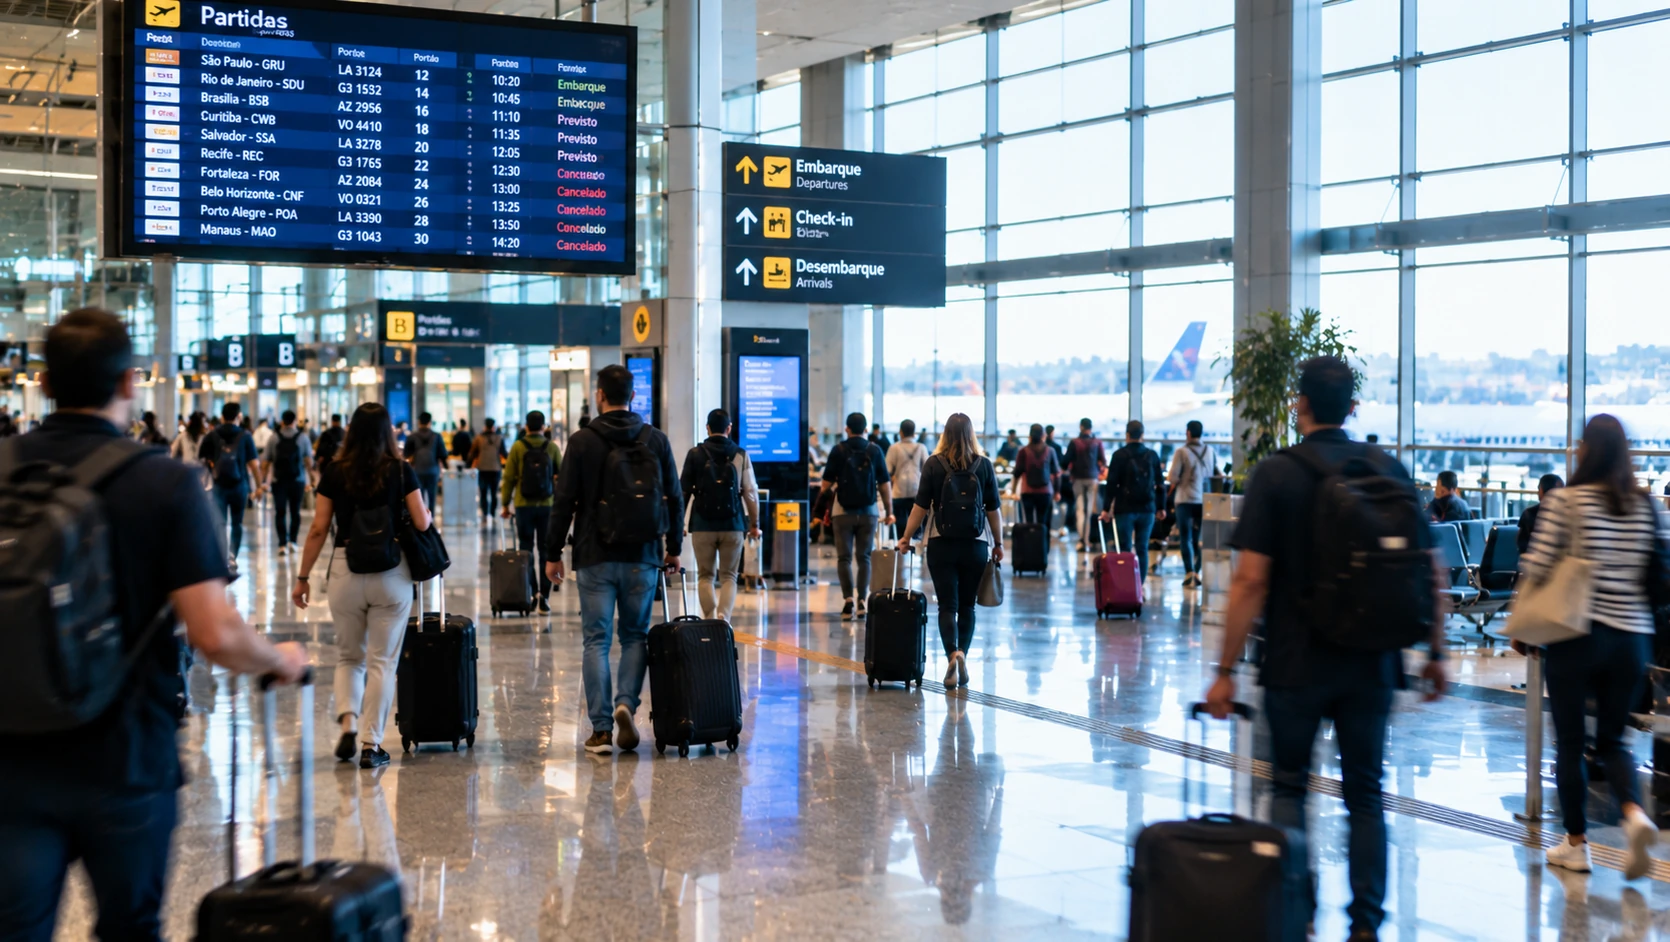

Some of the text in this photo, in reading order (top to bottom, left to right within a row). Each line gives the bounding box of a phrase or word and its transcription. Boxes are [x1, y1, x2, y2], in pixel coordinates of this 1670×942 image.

[201, 6, 288, 29] Partidas
[201, 55, 221, 66] São
[224, 56, 252, 68] Paulo
[262, 59, 284, 70] GRU
[339, 65, 352, 75] LA
[356, 66, 382, 77] 3124
[416, 70, 428, 80] 12
[493, 75, 520, 86] 10:20
[201, 73, 218, 84] Rio
[221, 75, 233, 85] de
[236, 76, 273, 87] Janeiro
[283, 79, 304, 90] SDU
[338, 83, 352, 93] G3
[416, 88, 429, 99] 14
[493, 93, 520, 104] 10:45
[249, 95, 269, 106] BSB
[338, 101, 352, 111] AZ
[356, 102, 381, 113] 2956
[416, 105, 429, 116] 16
[493, 110, 520, 122] 11:10
[558, 114, 597, 127] Previsto
[201, 111, 241, 123] Curitiba
[251, 114, 275, 125] CWB
[338, 120, 353, 130] VO
[356, 120, 382, 132] 4410
[416, 123, 429, 135] 18
[493, 128, 520, 140] 11:35
[558, 132, 597, 144] Previsto
[201, 129, 247, 141] Salvador
[256, 132, 276, 143] SSA
[339, 138, 352, 148] LA
[356, 138, 381, 150] 3278
[415, 141, 429, 153] 20
[493, 146, 520, 158] 12:05
[558, 150, 597, 162] Previsto
[201, 148, 233, 159] Recife
[243, 150, 263, 161] REC
[338, 156, 352, 166] G3
[357, 157, 381, 168] 1765
[415, 160, 428, 171] 22
[493, 165, 520, 176] 12:30
[796, 159, 862, 178] Embarque
[201, 167, 249, 179] Fortaleza
[259, 170, 279, 181] FOR
[338, 175, 352, 185] AZ
[356, 176, 382, 187] 2084
[414, 178, 429, 189] 24
[493, 184, 520, 194] 13:00
[796, 177, 848, 190] Departures
[201, 186, 223, 197] Belo
[226, 187, 275, 199] Horizonte
[283, 190, 304, 201] CNF
[338, 193, 353, 203] VO
[356, 194, 380, 205] 0321
[414, 197, 428, 208] 26
[493, 201, 520, 212] 13:25
[201, 205, 229, 216] Porto
[232, 207, 266, 220] Alegre
[276, 209, 297, 219] POA
[339, 212, 352, 222] LA
[356, 212, 381, 223] 3390
[414, 215, 428, 226] 28
[493, 219, 520, 230] 13:50
[796, 210, 853, 227] Check-in
[201, 224, 241, 235] Manaus
[251, 226, 276, 237] MAO
[338, 230, 352, 240] G3
[356, 231, 381, 242] 1043
[414, 233, 428, 244] 30
[493, 237, 519, 248] 14:20
[796, 258, 885, 278] Desembarque
[796, 277, 833, 289] Arrivals
[395, 318, 406, 334] B
[278, 342, 294, 366] B
